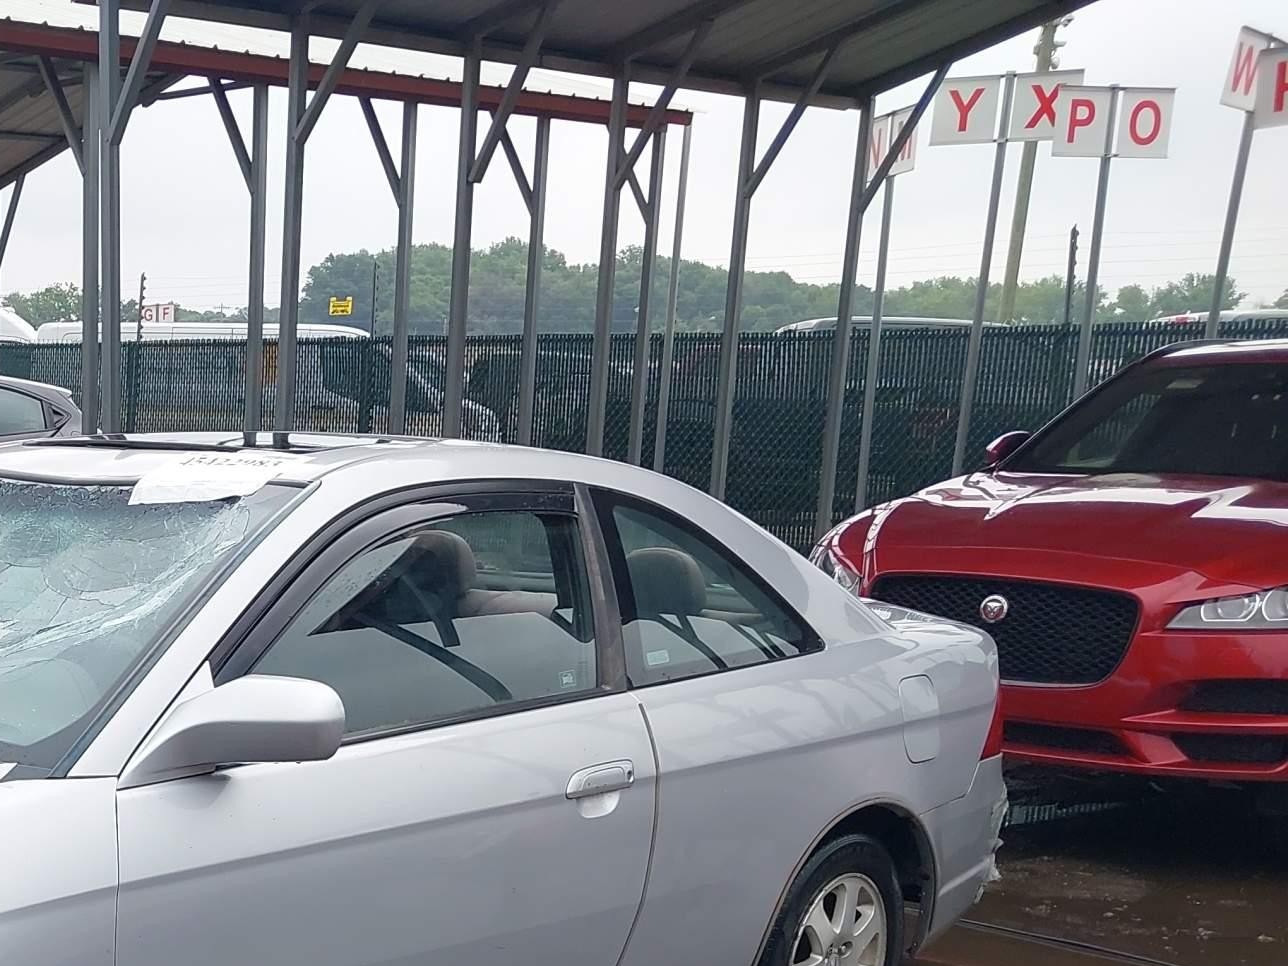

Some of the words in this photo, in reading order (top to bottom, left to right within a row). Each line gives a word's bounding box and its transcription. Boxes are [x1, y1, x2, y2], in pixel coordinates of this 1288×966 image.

[949, 87, 985, 132] Y
[1024, 84, 1060, 129] X
[1066, 99, 1096, 143] P
[144, 308, 153, 321] G
[163, 307, 170, 320] F
